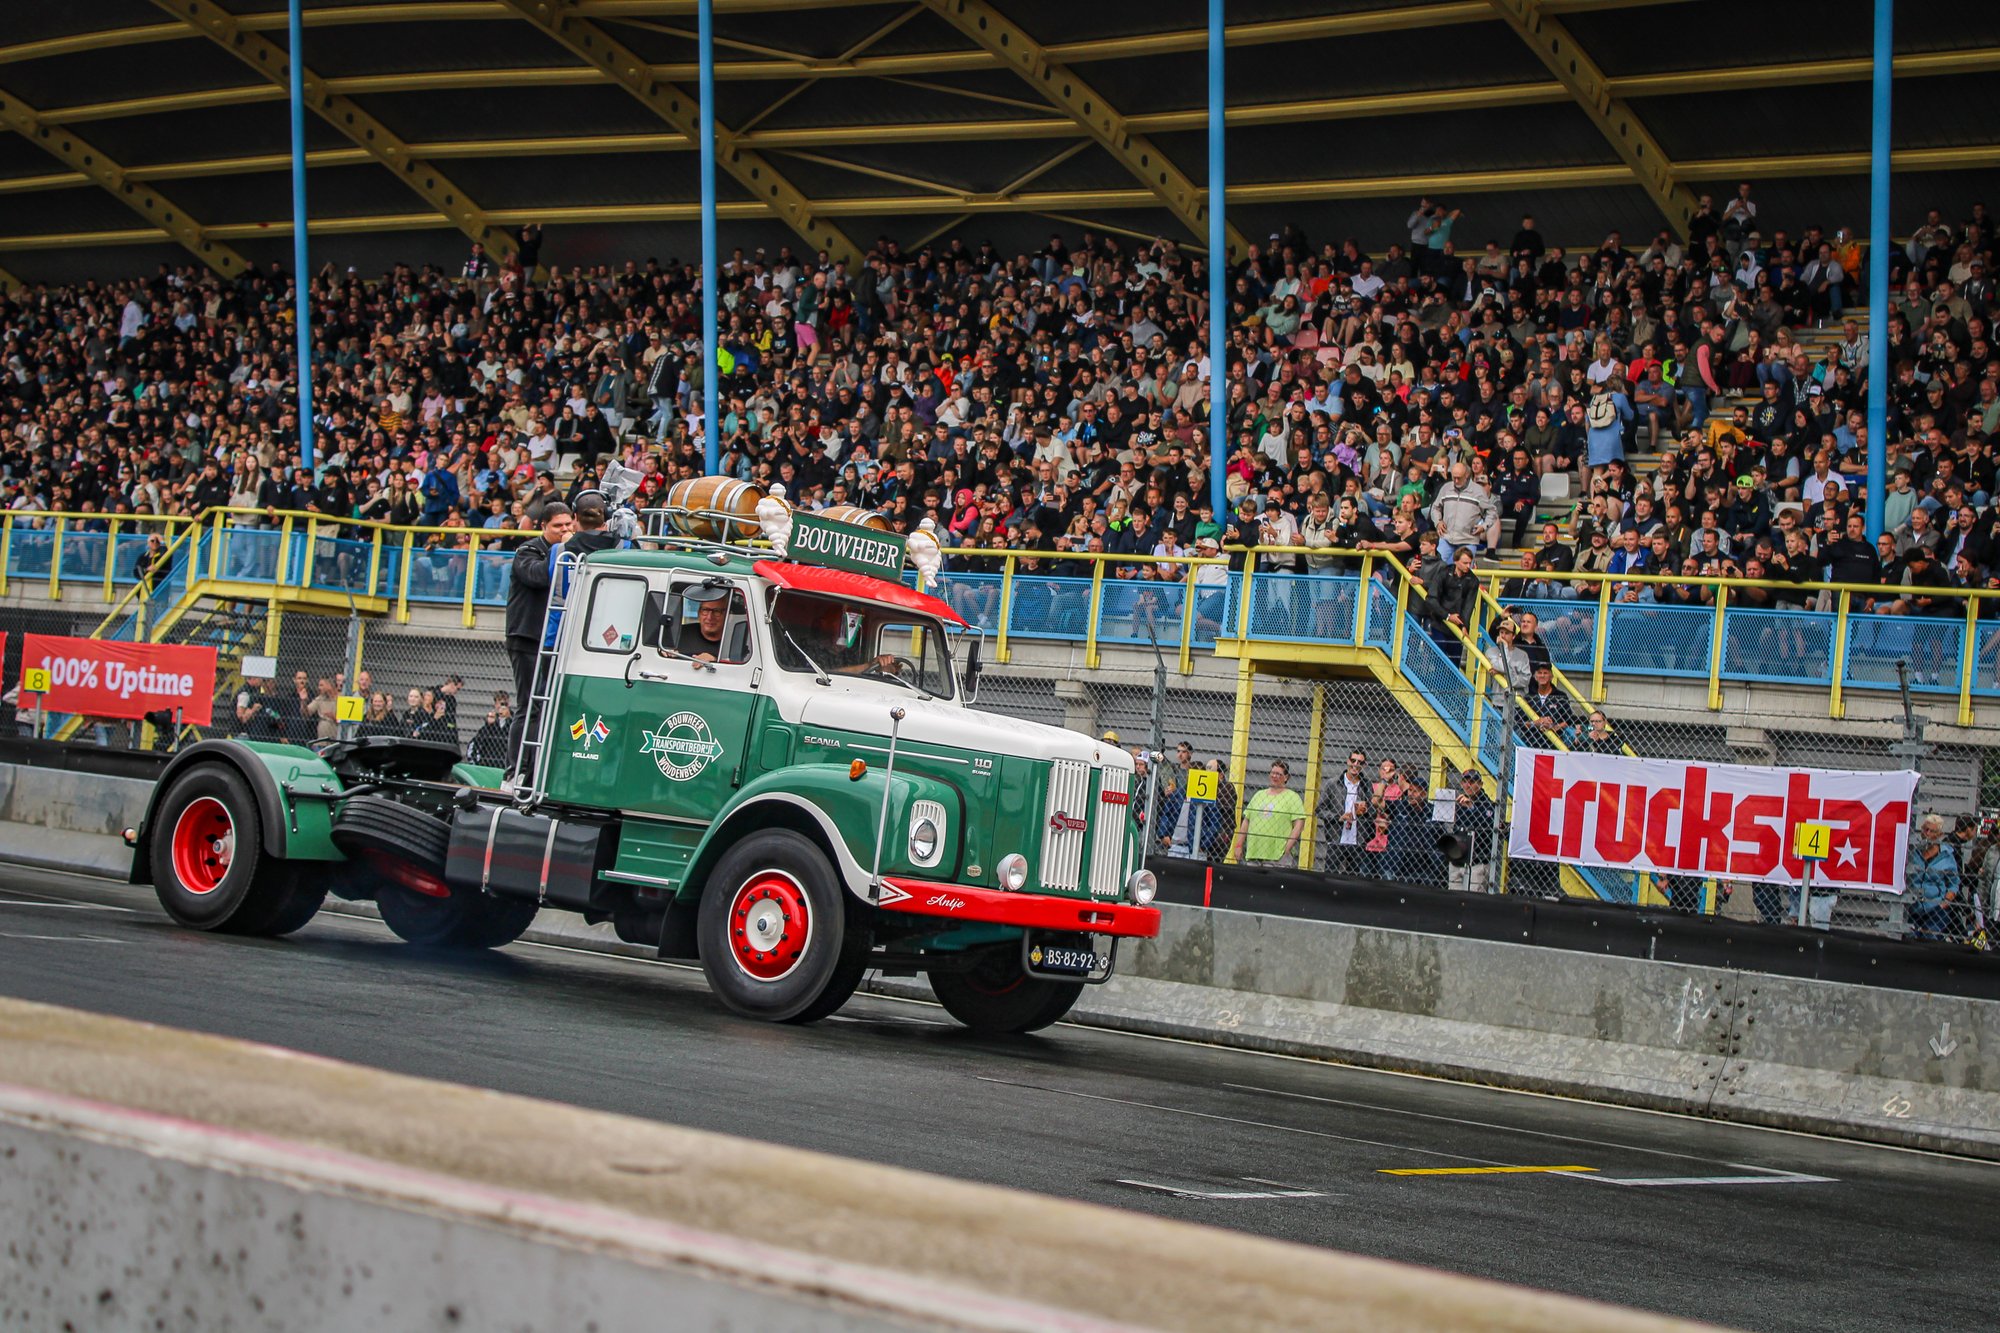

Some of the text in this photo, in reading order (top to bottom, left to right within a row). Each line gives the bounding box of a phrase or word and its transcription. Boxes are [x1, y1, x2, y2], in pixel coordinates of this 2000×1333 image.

[794, 524, 899, 569] BOUWHEER
[32, 672, 44, 690] 8
[105, 661, 194, 699] Uptime
[347, 700, 355, 718] 7
[667, 714, 705, 732] BOUWHEER
[652, 738, 715, 755] TRANSPORTBEDRIJF
[804, 735, 841, 748] SCANIA
[572, 752, 599, 760] HOLLAND
[974, 758, 992, 769] 110
[658, 755, 702, 779] WOUDENBERG
[1196, 774, 1208, 797] 5
[1050, 810, 1085, 835] SUPER
[1528, 754, 1908, 886] truckstar
[1808, 829, 1820, 854] 4
[926, 894, 965, 911] Antje
[1882, 1095, 1912, 1118] 42
